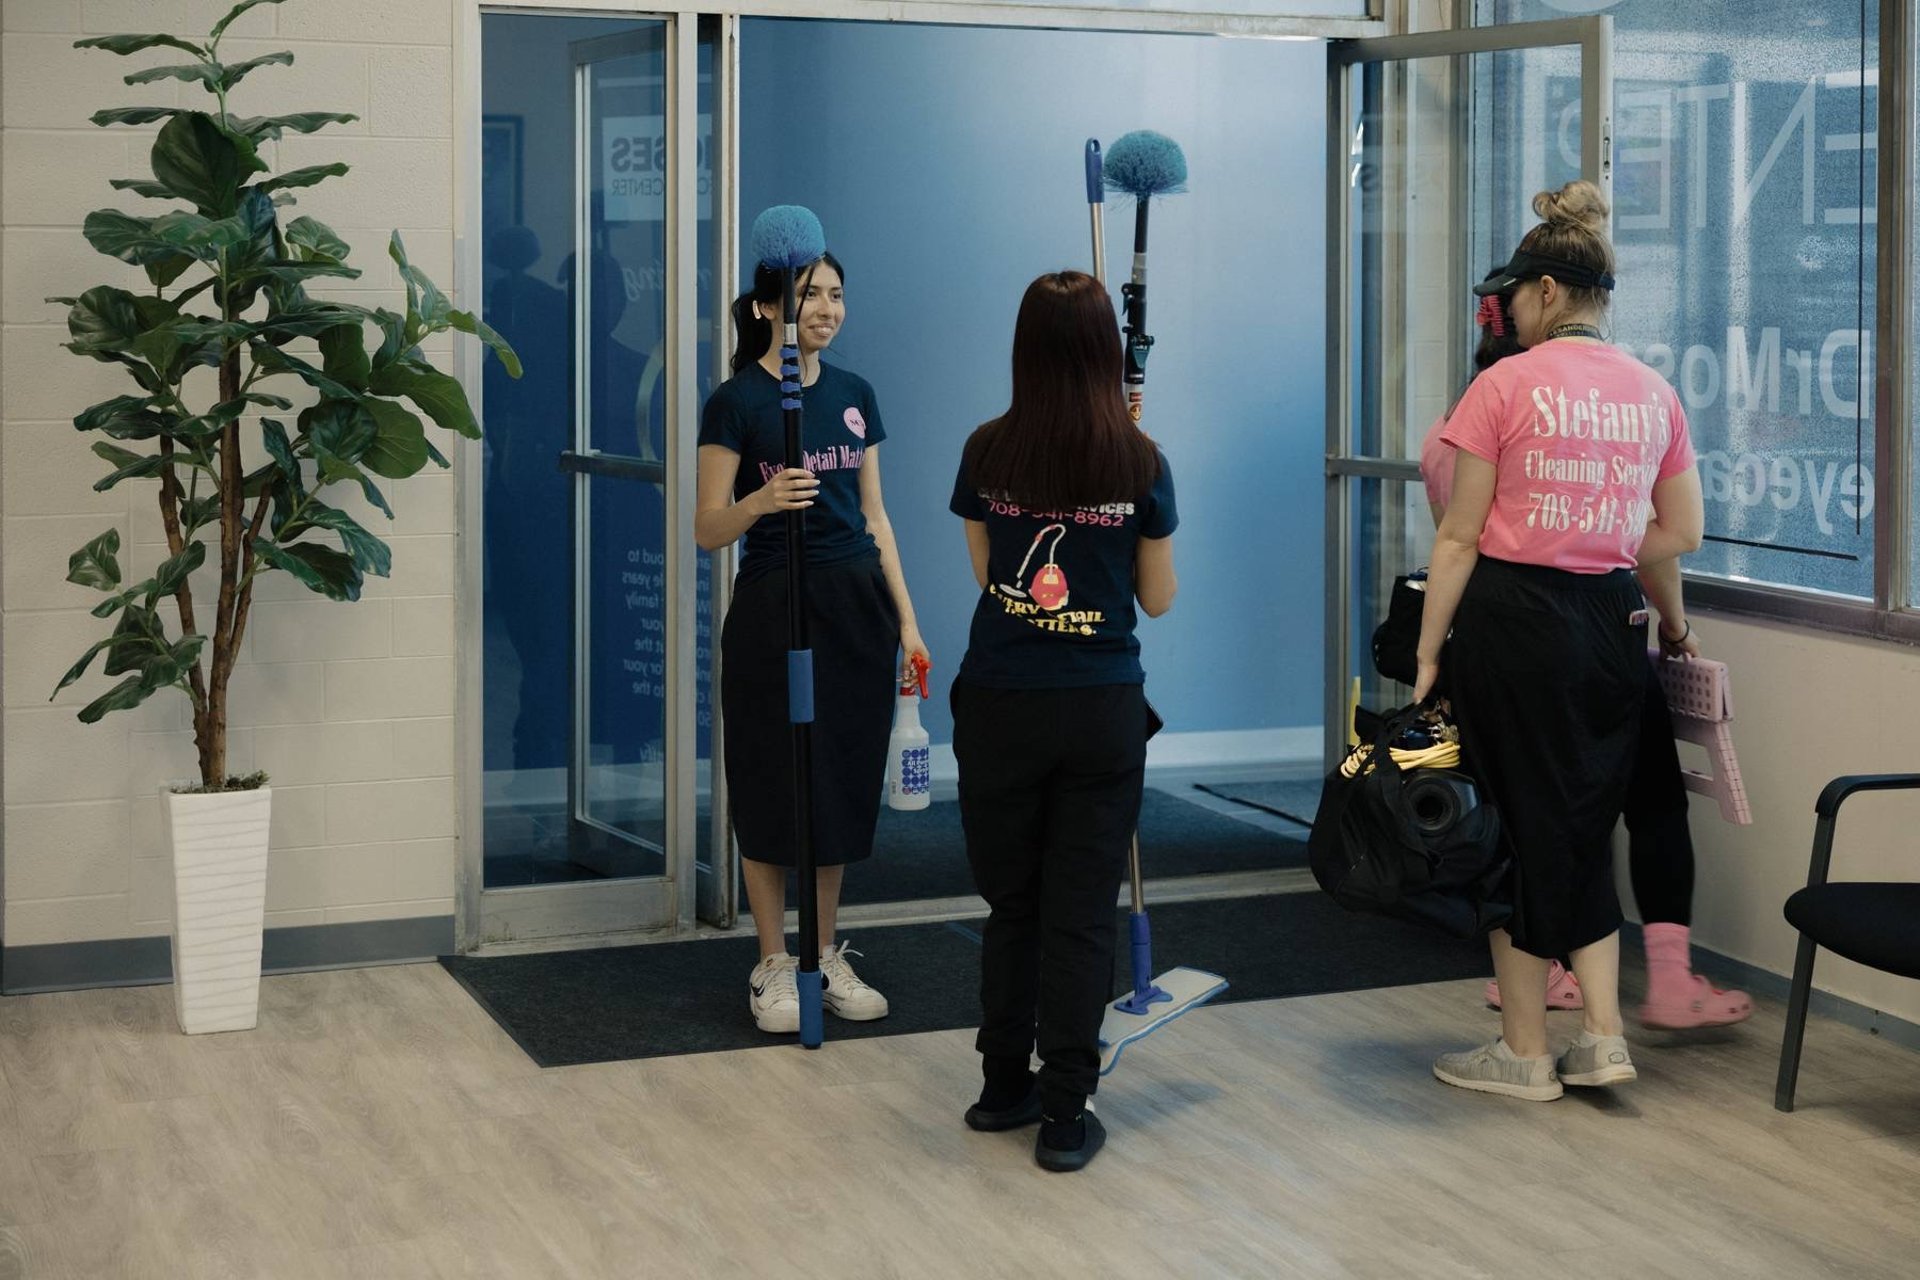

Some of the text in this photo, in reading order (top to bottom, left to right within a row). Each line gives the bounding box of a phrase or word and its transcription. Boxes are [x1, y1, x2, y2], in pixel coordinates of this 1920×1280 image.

[1532, 385, 1670, 455] Stefany's
[802, 446, 838, 474] Detail
[1525, 450, 1606, 489] Cleaning
